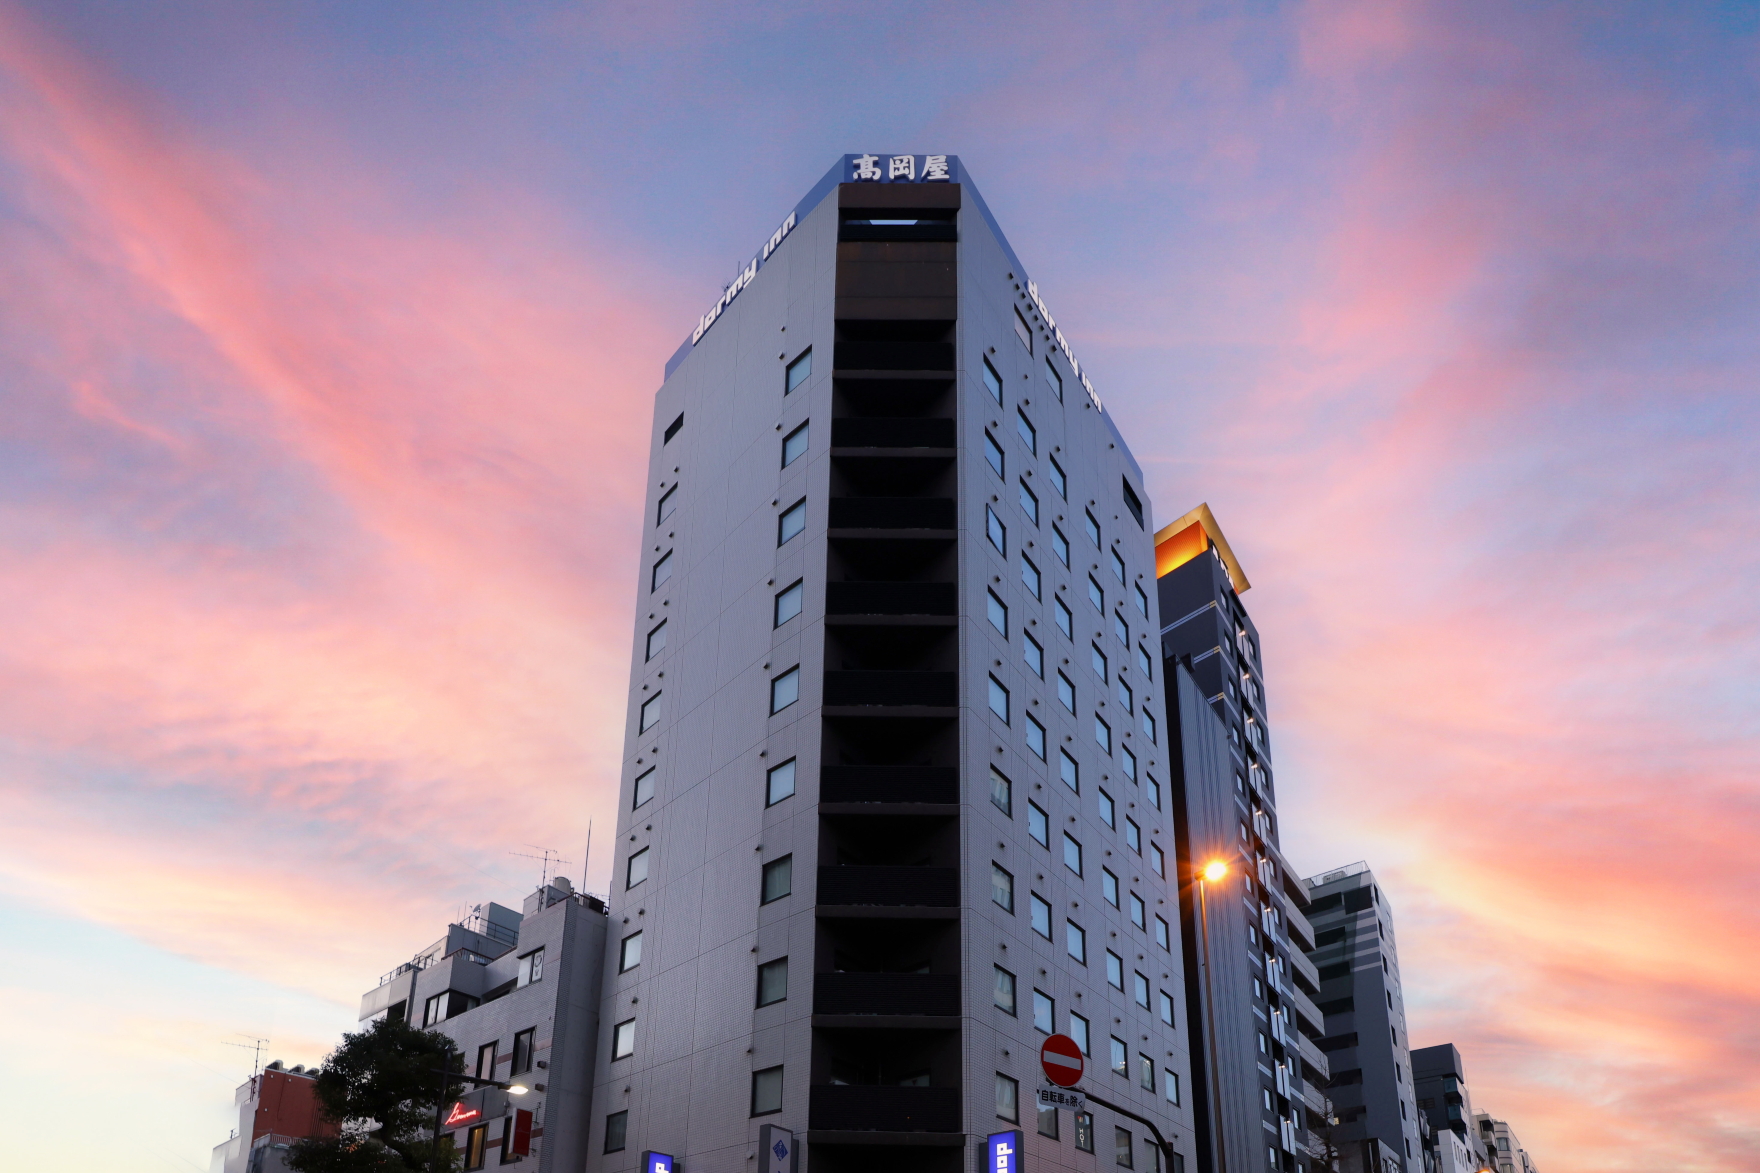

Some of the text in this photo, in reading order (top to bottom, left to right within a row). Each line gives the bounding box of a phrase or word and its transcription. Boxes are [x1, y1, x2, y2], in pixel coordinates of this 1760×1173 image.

[692, 211, 796, 346] dormy inn
[1027, 279, 1102, 414] dormy inn
[1041, 1089, 1083, 1108] 自転車を除く
